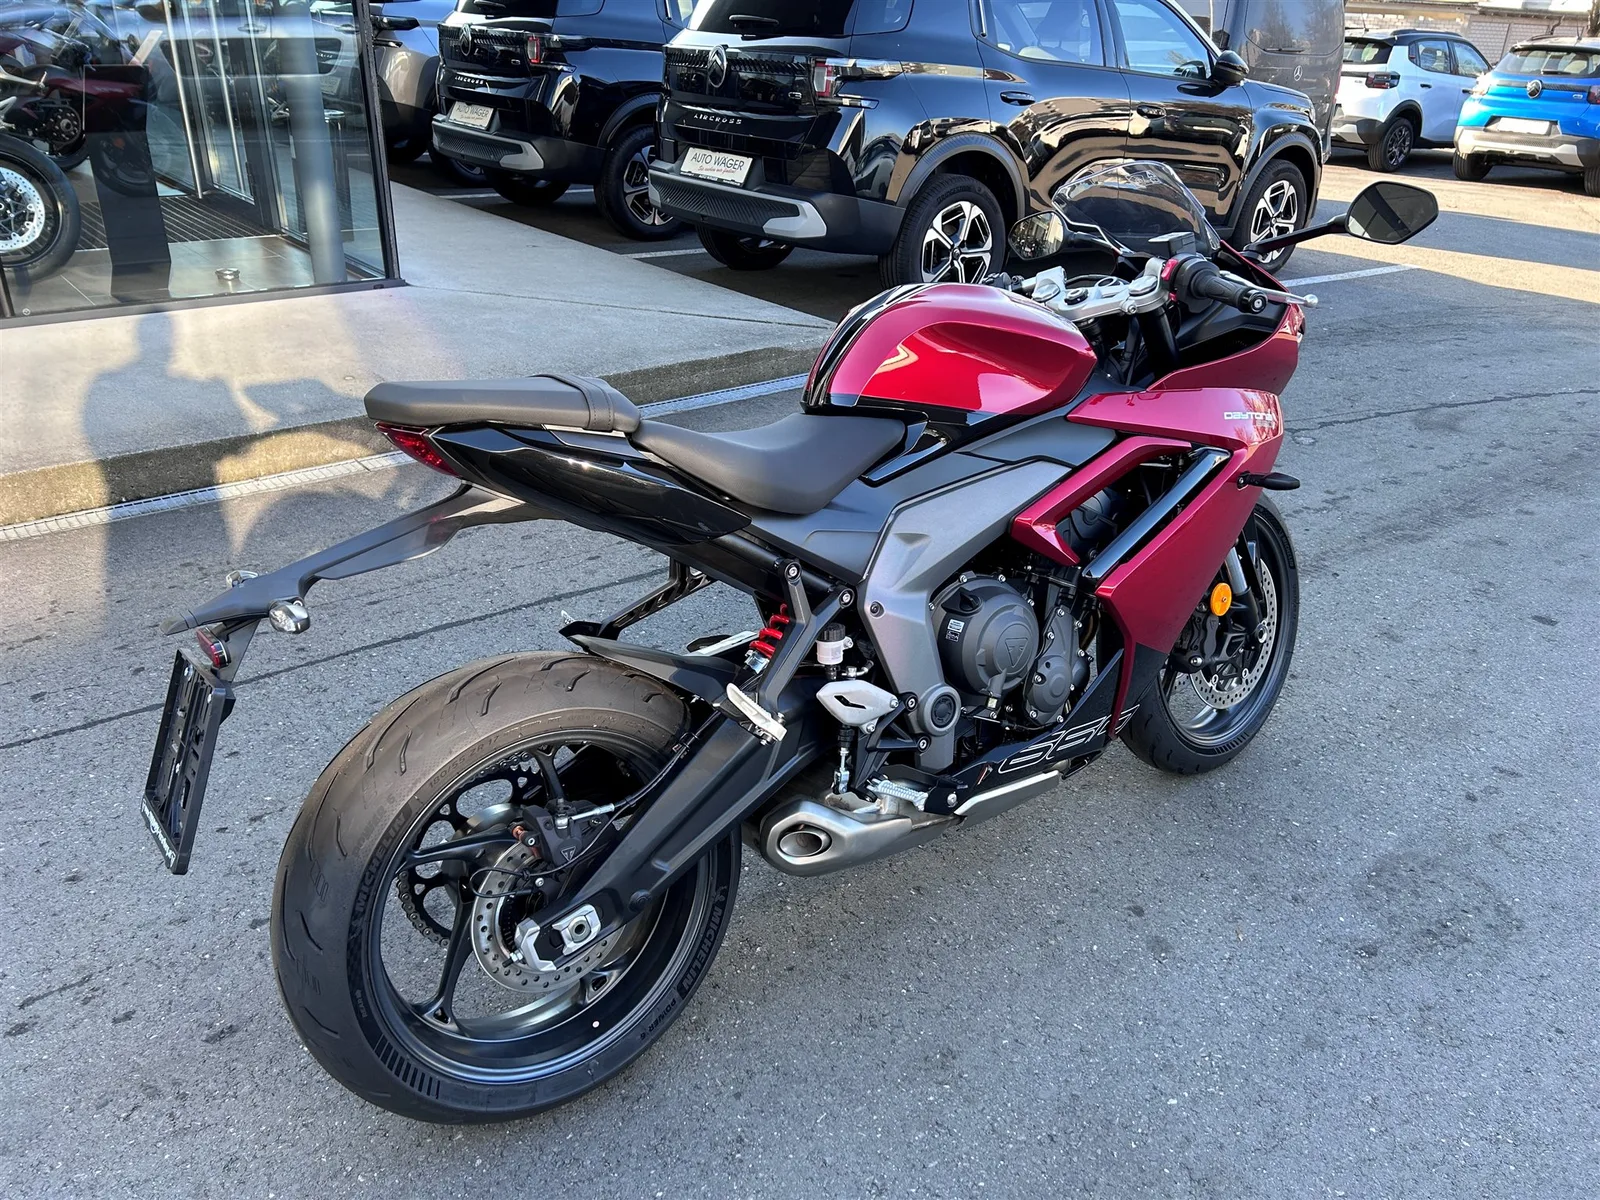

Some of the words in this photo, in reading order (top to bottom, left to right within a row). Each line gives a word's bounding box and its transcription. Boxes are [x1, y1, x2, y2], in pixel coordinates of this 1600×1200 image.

[694, 113, 742, 125] AIRCROSS
[690, 152, 713, 165] AUTO
[713, 154, 745, 171] WÄGER
[354, 811, 405, 912] MICHELIN
[682, 904, 724, 993] MICHELIN
[648, 998, 677, 1033] POWER
